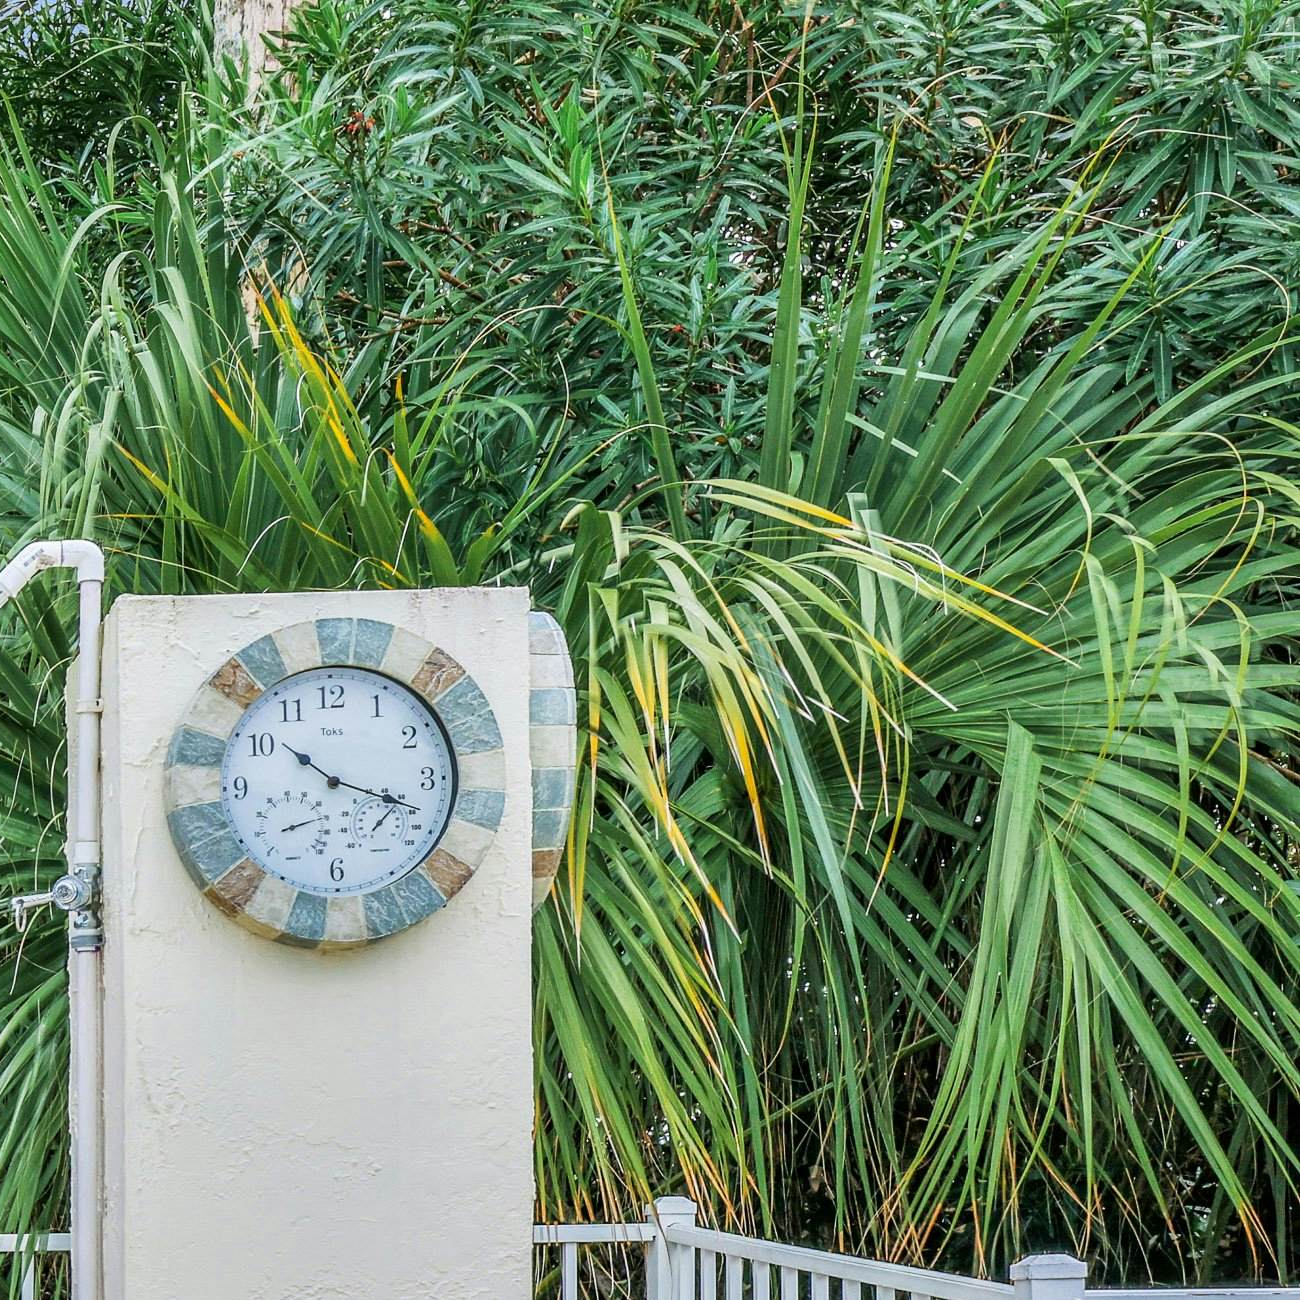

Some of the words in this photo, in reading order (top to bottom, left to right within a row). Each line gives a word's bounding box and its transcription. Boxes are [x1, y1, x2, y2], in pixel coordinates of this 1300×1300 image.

[315, 685, 345, 709] 12
[371, 694, 384, 718] 1
[279, 699, 304, 722] 11
[247, 732, 275, 757] 10
[401, 725, 418, 749] 2
[233, 775, 248, 800] 9
[420, 766, 436, 791] 3
[330, 857, 345, 882] 6
